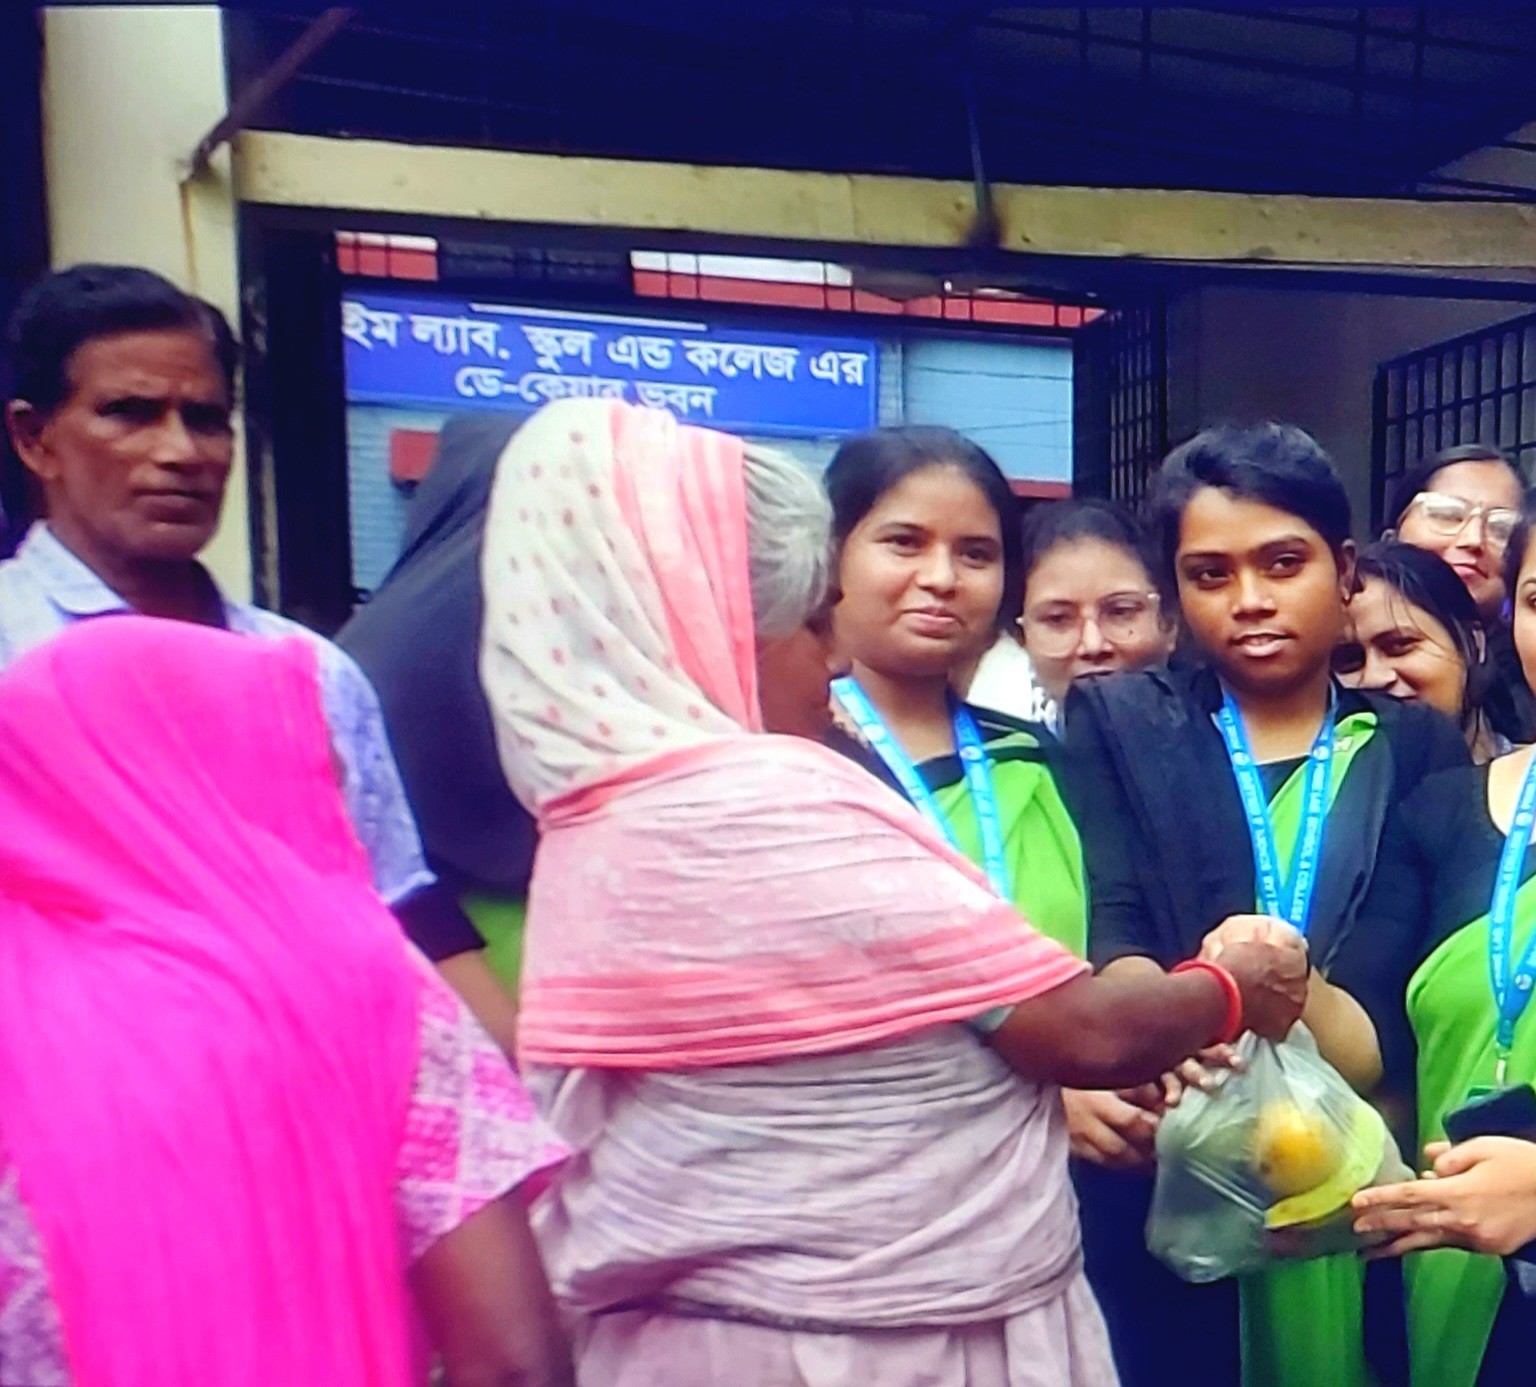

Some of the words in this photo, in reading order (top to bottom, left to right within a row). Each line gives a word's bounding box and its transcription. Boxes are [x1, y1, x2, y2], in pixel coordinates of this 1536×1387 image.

[520, 325, 598, 373] স্কুল
[681, 338, 799, 382] কলেজ
[809, 350, 868, 387] এর
[634, 380, 718, 417] ভবন
